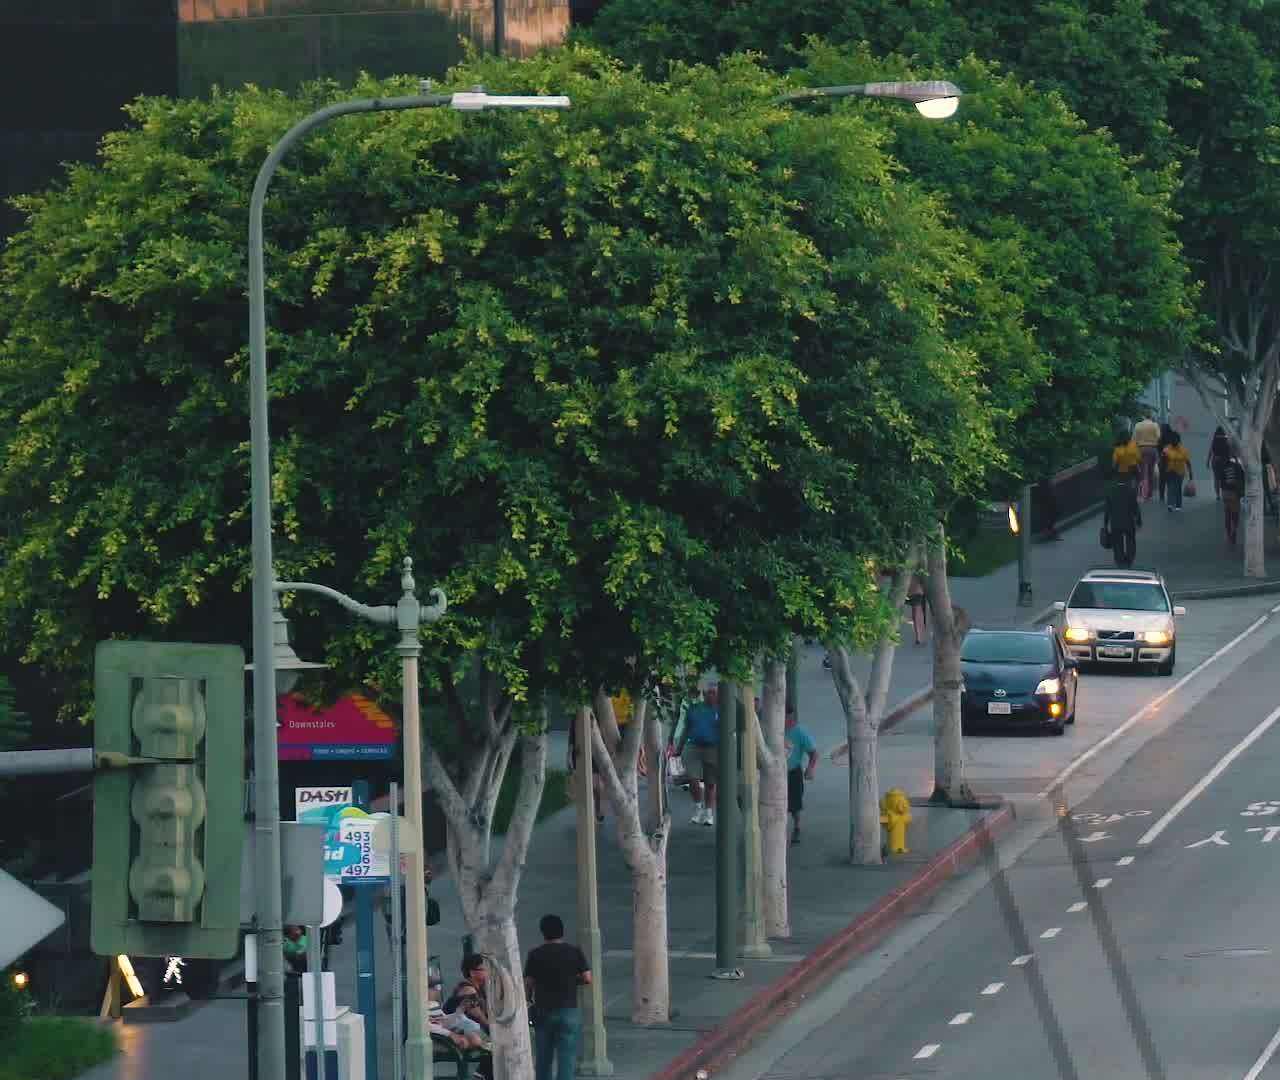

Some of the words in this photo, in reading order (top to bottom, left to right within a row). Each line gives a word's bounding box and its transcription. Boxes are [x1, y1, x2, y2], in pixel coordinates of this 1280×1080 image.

[300, 790, 349, 803] DASH
[344, 831, 371, 842] 493
[344, 866, 371, 876] 497
